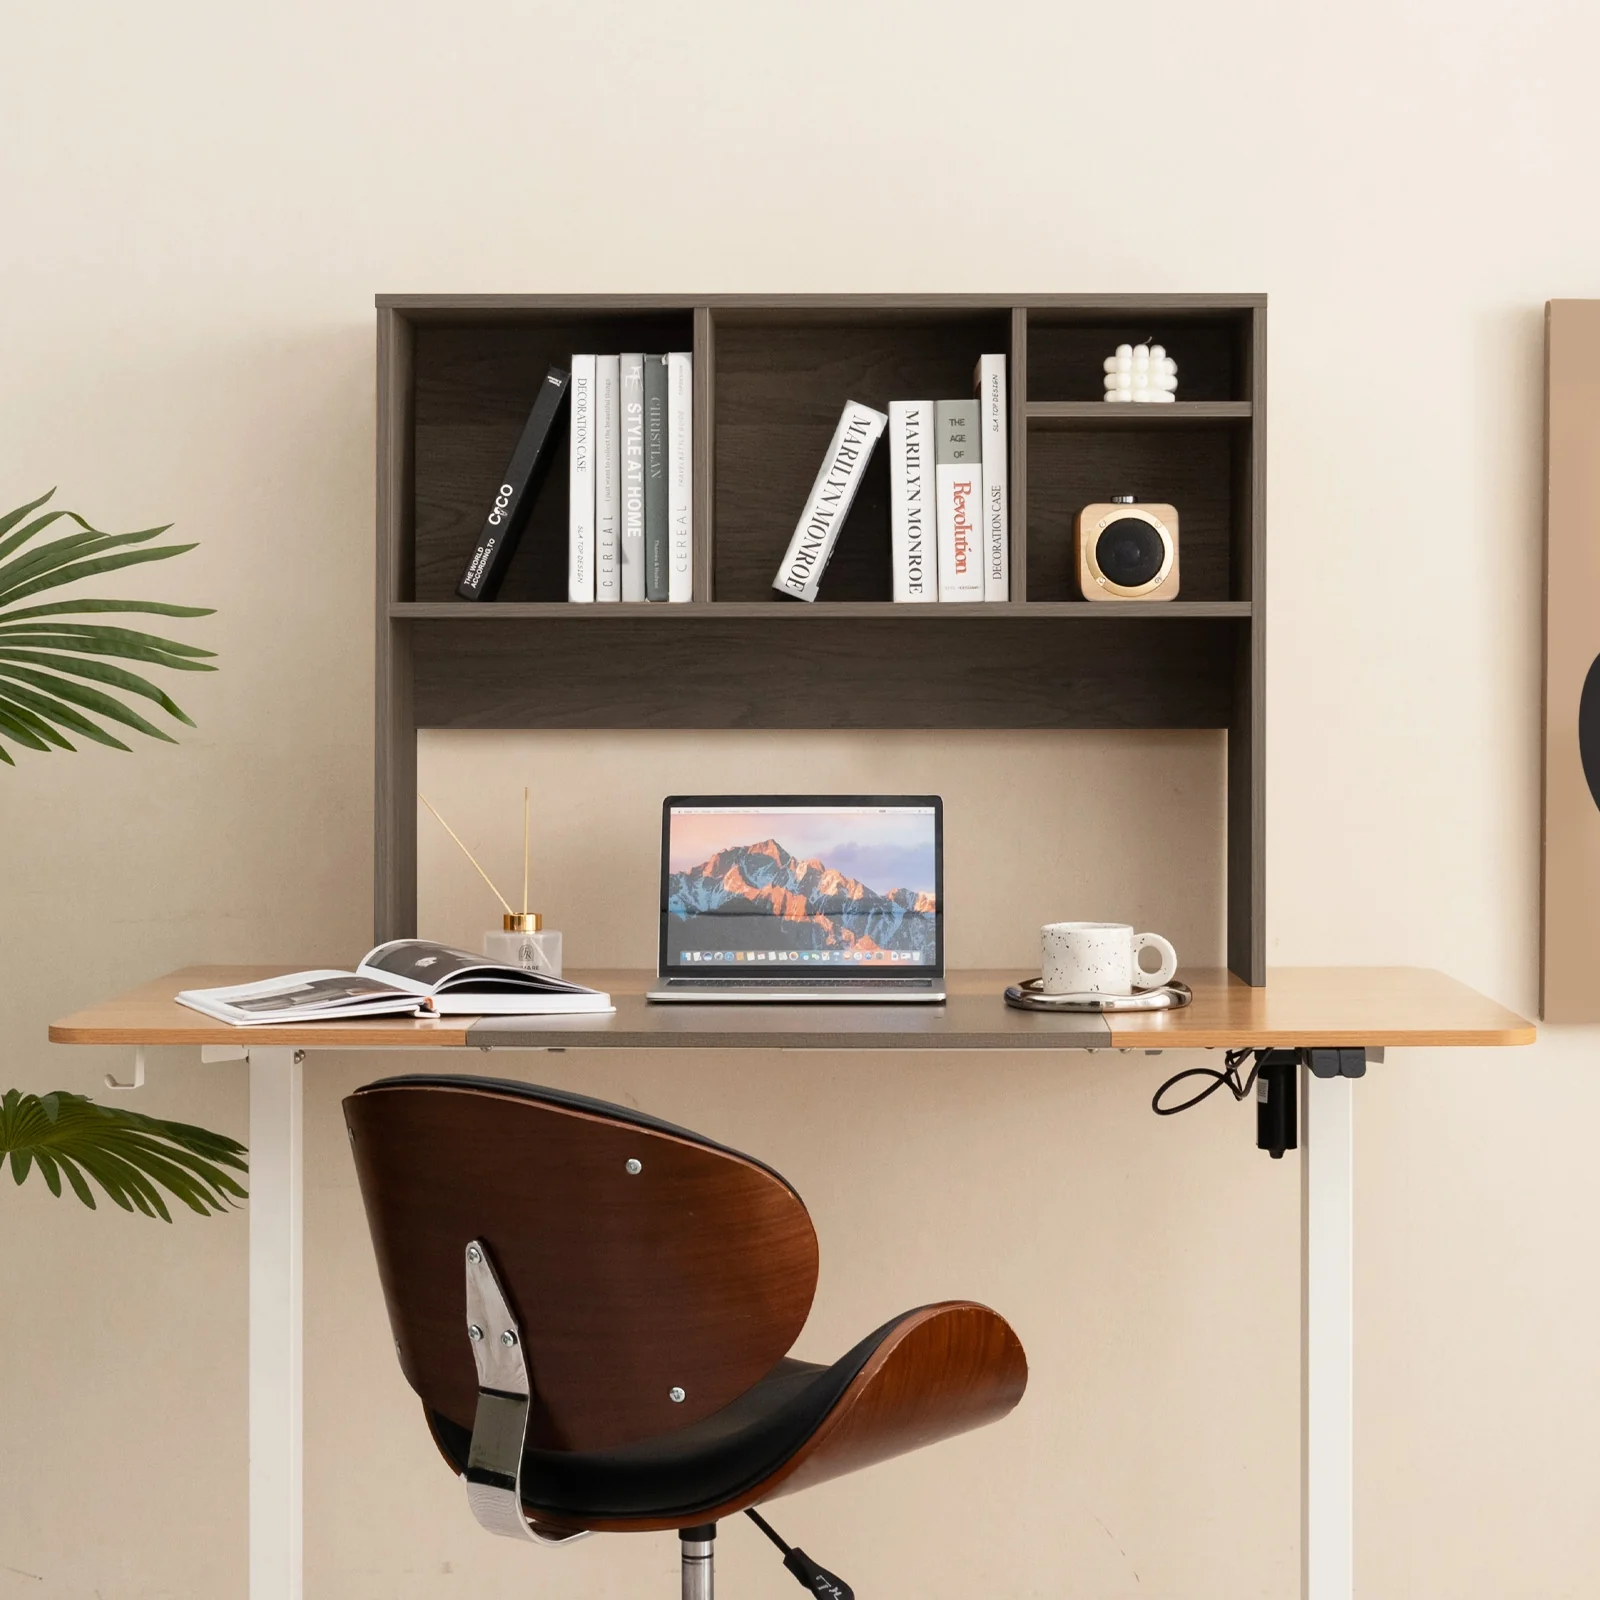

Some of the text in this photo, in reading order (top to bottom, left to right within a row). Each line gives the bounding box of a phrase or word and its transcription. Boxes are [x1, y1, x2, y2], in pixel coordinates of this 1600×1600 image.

[577, 378, 587, 472] DECORATION CASE
[949, 418, 966, 426] THE
[950, 434, 966, 442] AGE
[954, 450, 964, 458] OF
[628, 403, 642, 537] STYLE AT HOME
[785, 414, 872, 592] MARILYN MONROE
[906, 410, 922, 594] MARILYN MONROE
[603, 516, 613, 586] CEREAL
[677, 506, 688, 572] CEREAL
[953, 481, 972, 574] Revolution
[992, 486, 1002, 580] DECORATION CASE
[464, 546, 484, 585] THE WORLD
[470, 538, 496, 588] ACCORDING TO
